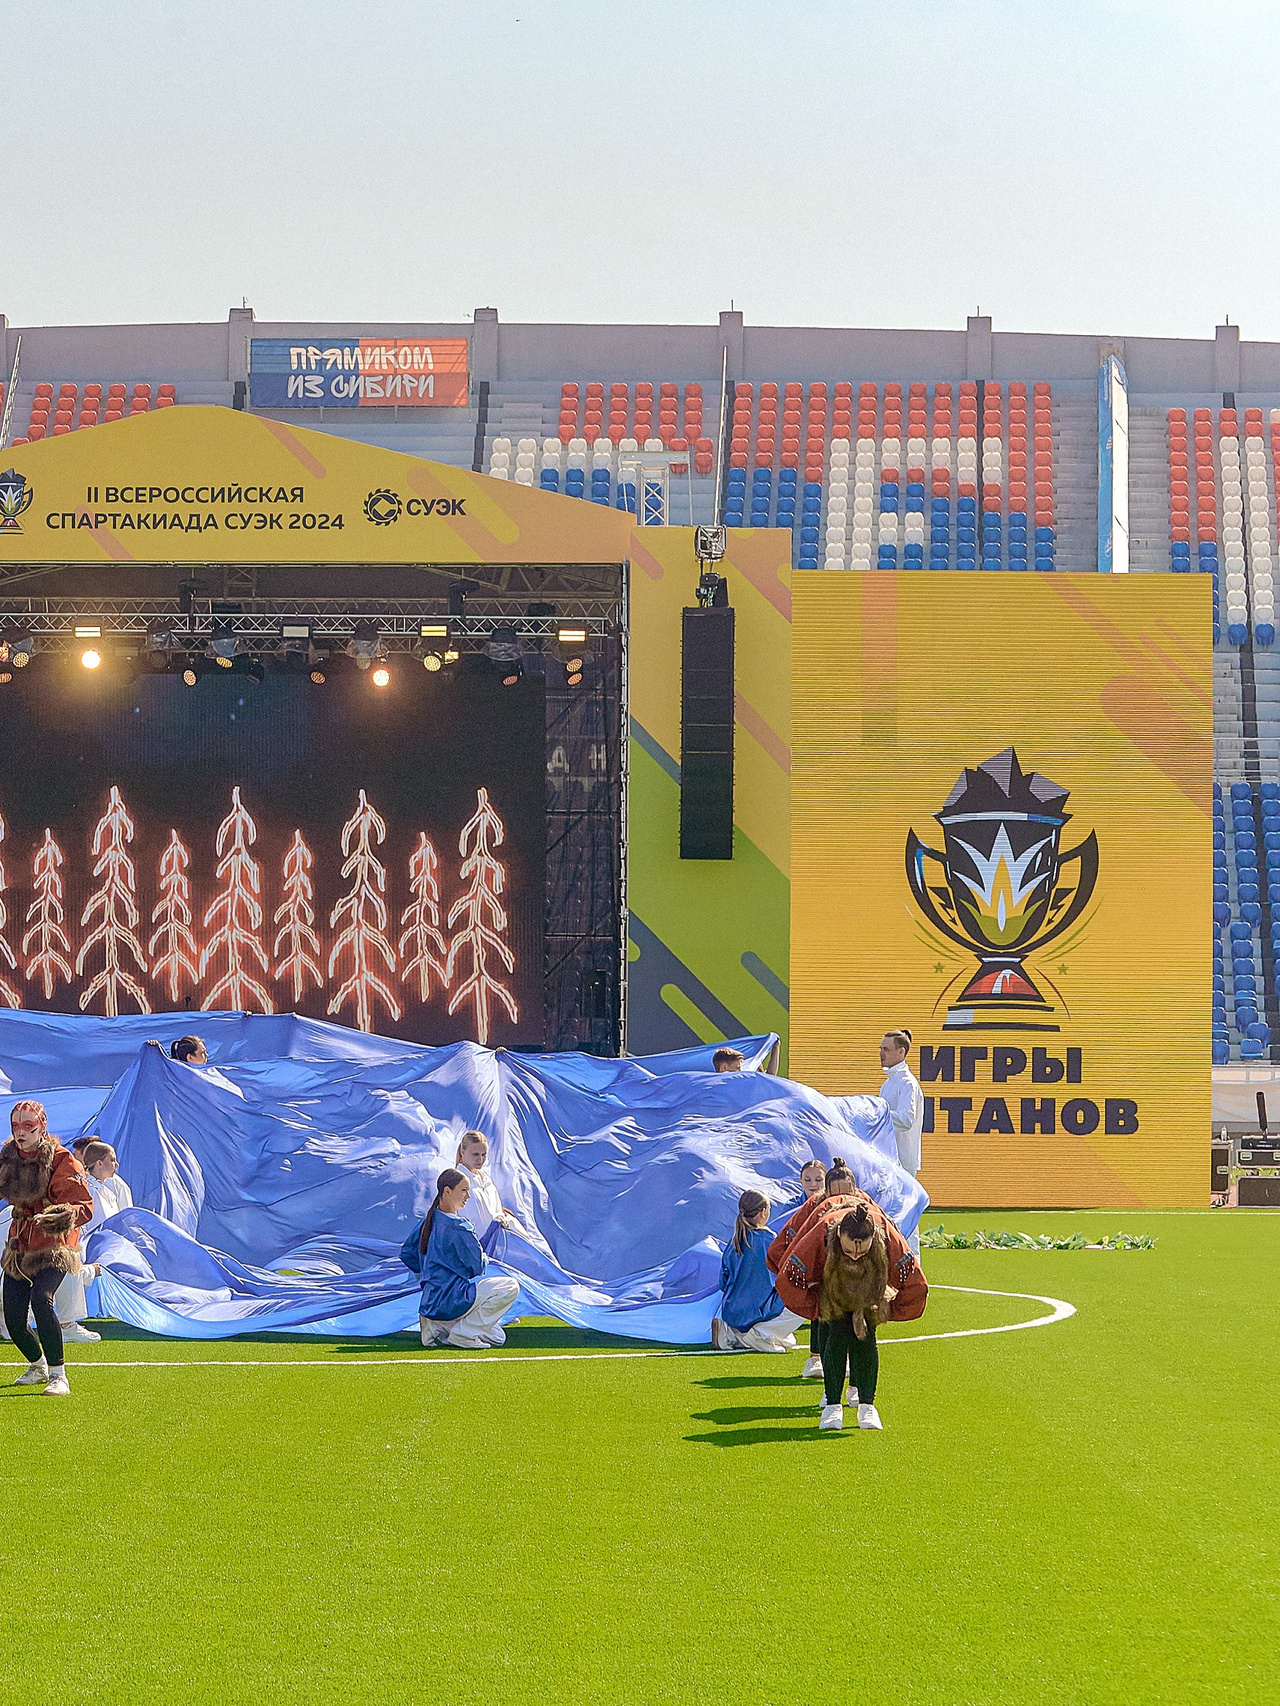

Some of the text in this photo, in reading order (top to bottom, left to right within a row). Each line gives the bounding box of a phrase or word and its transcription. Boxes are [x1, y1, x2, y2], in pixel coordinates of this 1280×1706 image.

[289, 346, 434, 370] ПРЯМИКОМ
[287, 374, 434, 398] ИЗ СИБИРИ
[105, 483, 304, 503] ВСЕРОССИЙСКАЯ
[406, 498, 467, 515] СУЭК
[45, 512, 345, 533] СПАРТАКИАДА СУЭК 2024
[920, 1046, 1082, 1083] ИГРЫ
[922, 1098, 1139, 1135] ТАНОВ
